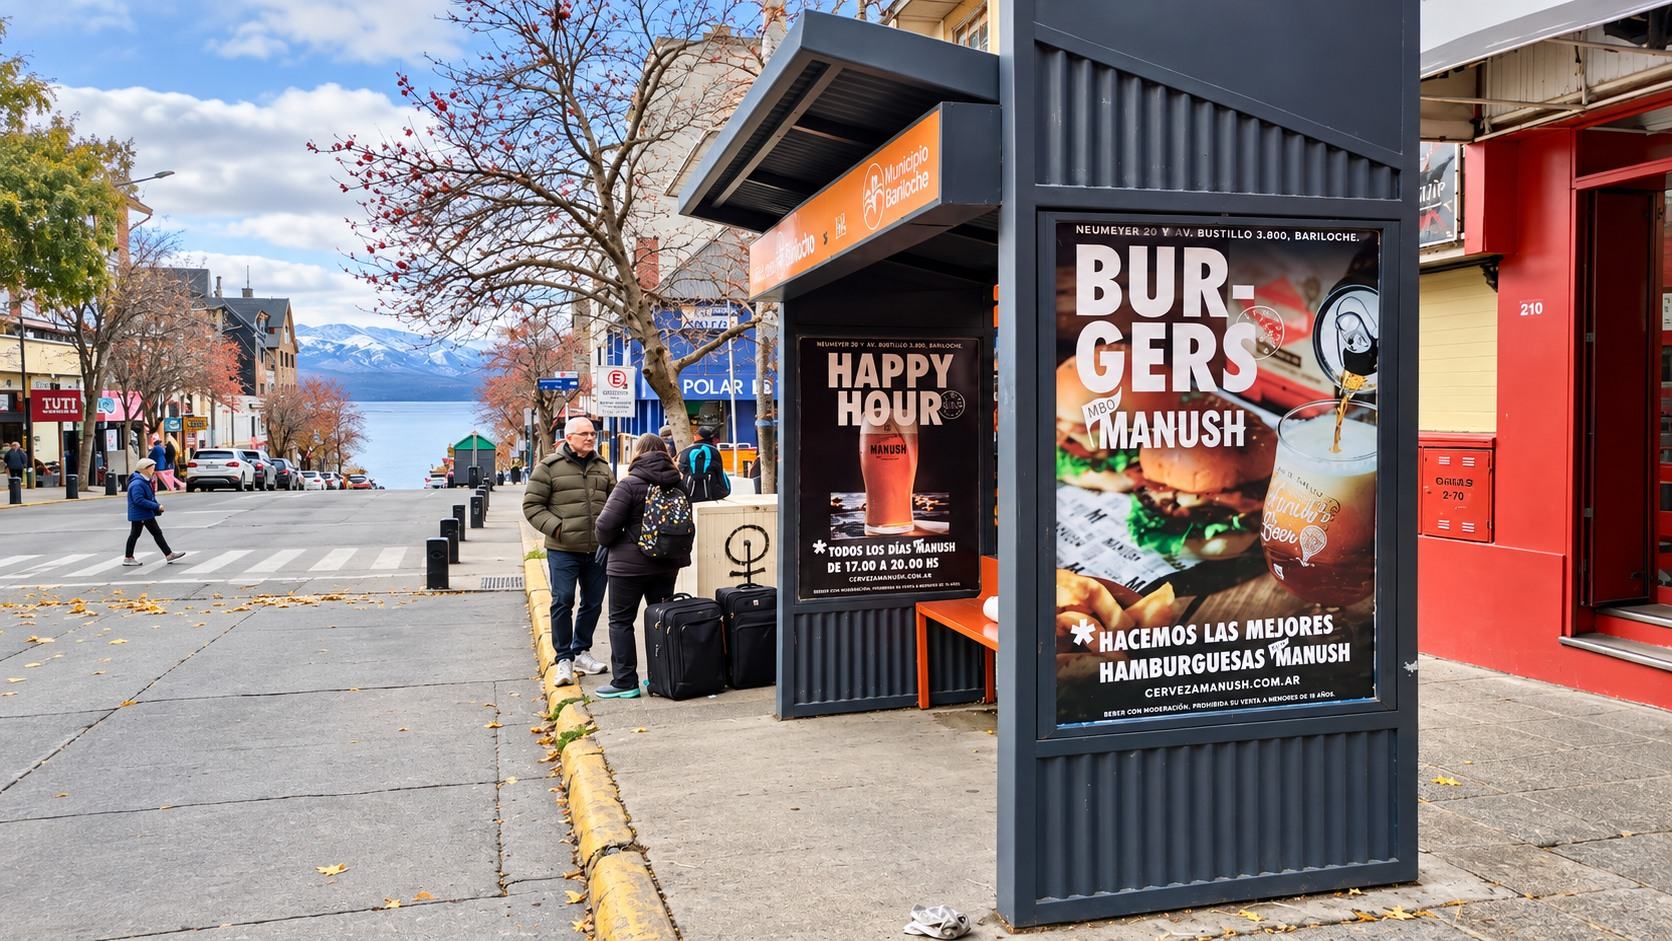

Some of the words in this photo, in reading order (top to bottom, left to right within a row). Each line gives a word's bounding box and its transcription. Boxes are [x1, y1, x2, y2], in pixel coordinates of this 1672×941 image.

[885, 144, 929, 186] Municipio
[1076, 225, 1139, 236] NEUMEYER
[1143, 227, 1158, 236] 20
[1162, 227, 1170, 236] Y
[1175, 228, 1194, 238] AV.
[1197, 229, 1253, 239] BUSTILLO
[1256, 230, 1291, 241] 3.800,
[1294, 231, 1360, 242] BARILOCHE.
[1076, 244, 1255, 318] BUR-
[1520, 302, 1543, 316] 210
[1076, 320, 1257, 393] GERS
[828, 352, 954, 389] HAPPY
[683, 379, 743, 395] POLAR
[838, 390, 943, 427] HOUR
[1099, 410, 1246, 450] MANUSH
[870, 444, 907, 455] MANUSH
[1442, 491, 1464, 501] 2-70
[828, 545, 863, 557] TODOS
[866, 544, 885, 556] LOS
[888, 541, 912, 555] DÍAS
[915, 541, 956, 554] MANUSH
[827, 562, 841, 573] DE
[845, 560, 876, 573] 17.00
[880, 560, 887, 571] A
[891, 558, 923, 570] 20.00
[926, 558, 939, 569] HS
[1099, 624, 1197, 653] HACEMOS
[1204, 621, 1239, 643] LAS
[1246, 614, 1334, 640] MEJORES
[1099, 648, 1265, 684] HAMBURGUESAS
[1276, 642, 1351, 667] MANUSH
[1145, 675, 1301, 698] CERVEZAMANUSH.COM.AR
[1104, 710, 1126, 718] BEBER
[1192, 701, 1229, 709] PROHIBIDA
[1268, 694, 1299, 703] MENORES
